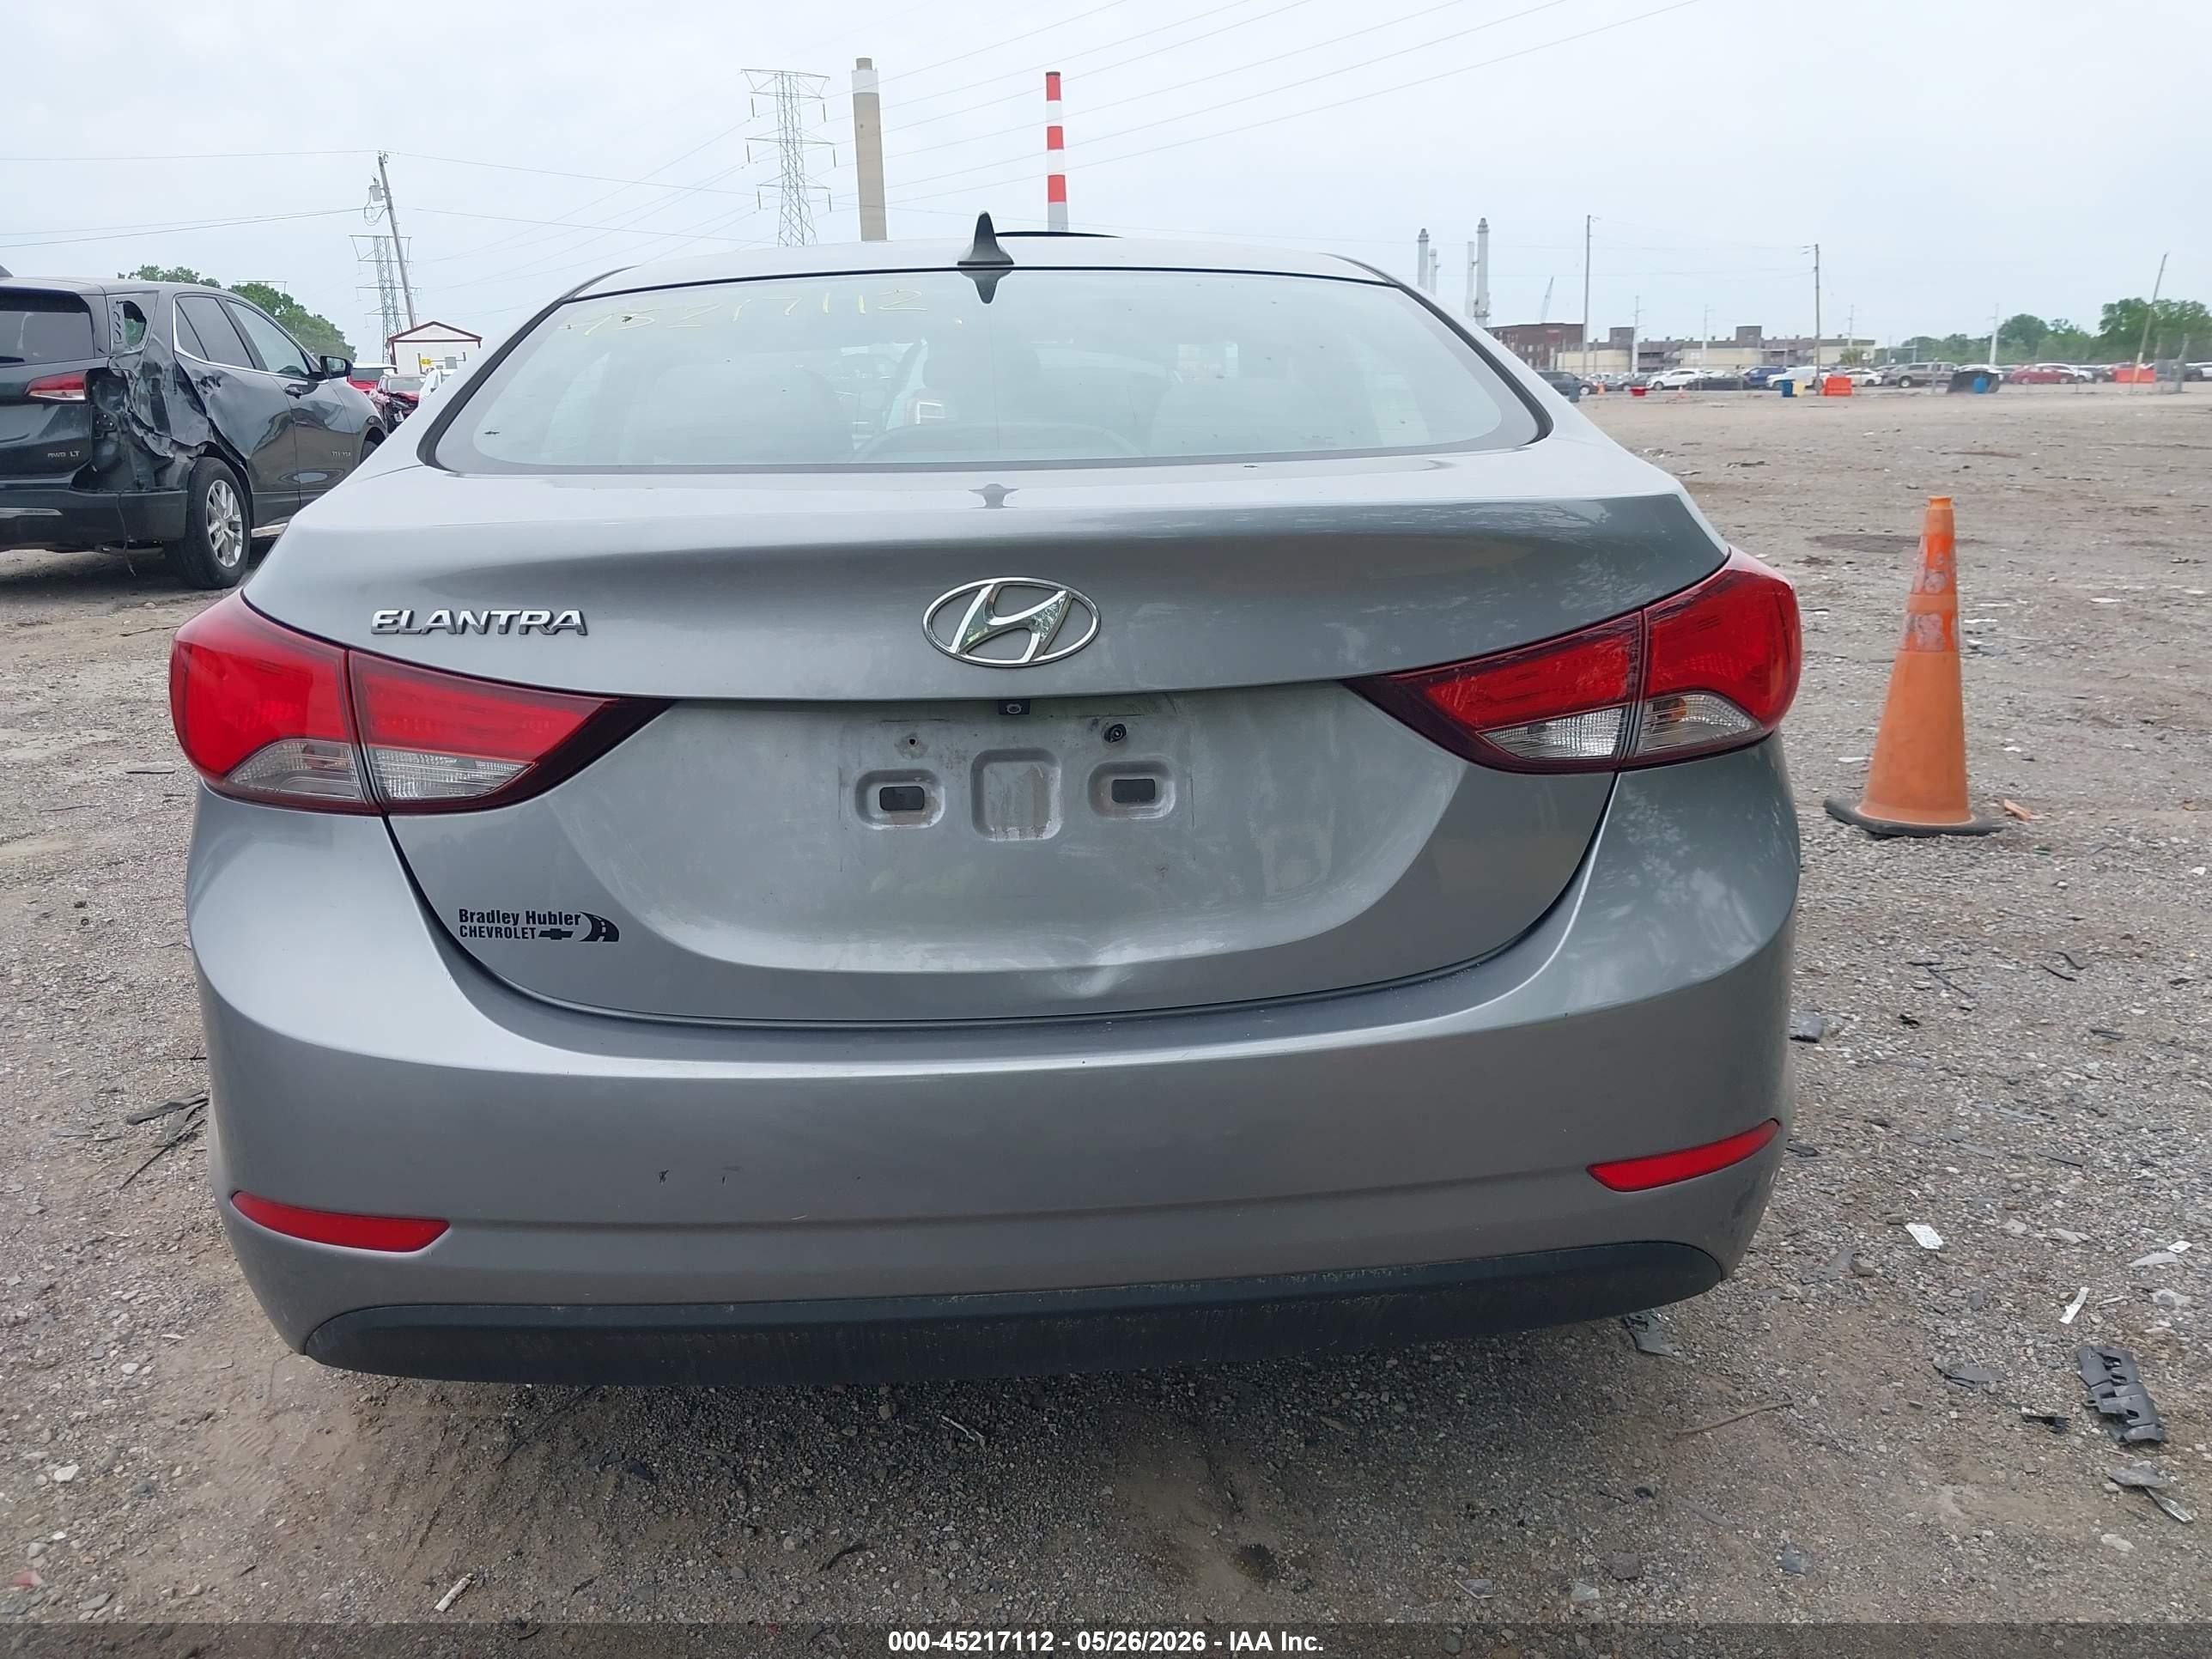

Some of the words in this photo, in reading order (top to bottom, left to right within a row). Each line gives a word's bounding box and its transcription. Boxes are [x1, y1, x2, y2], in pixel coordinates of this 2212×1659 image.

[370, 609, 588, 635] ELANTRA
[459, 908, 520, 927] Bradley
[526, 910, 581, 926] Hubler
[459, 925, 537, 939] CHEVROLET
